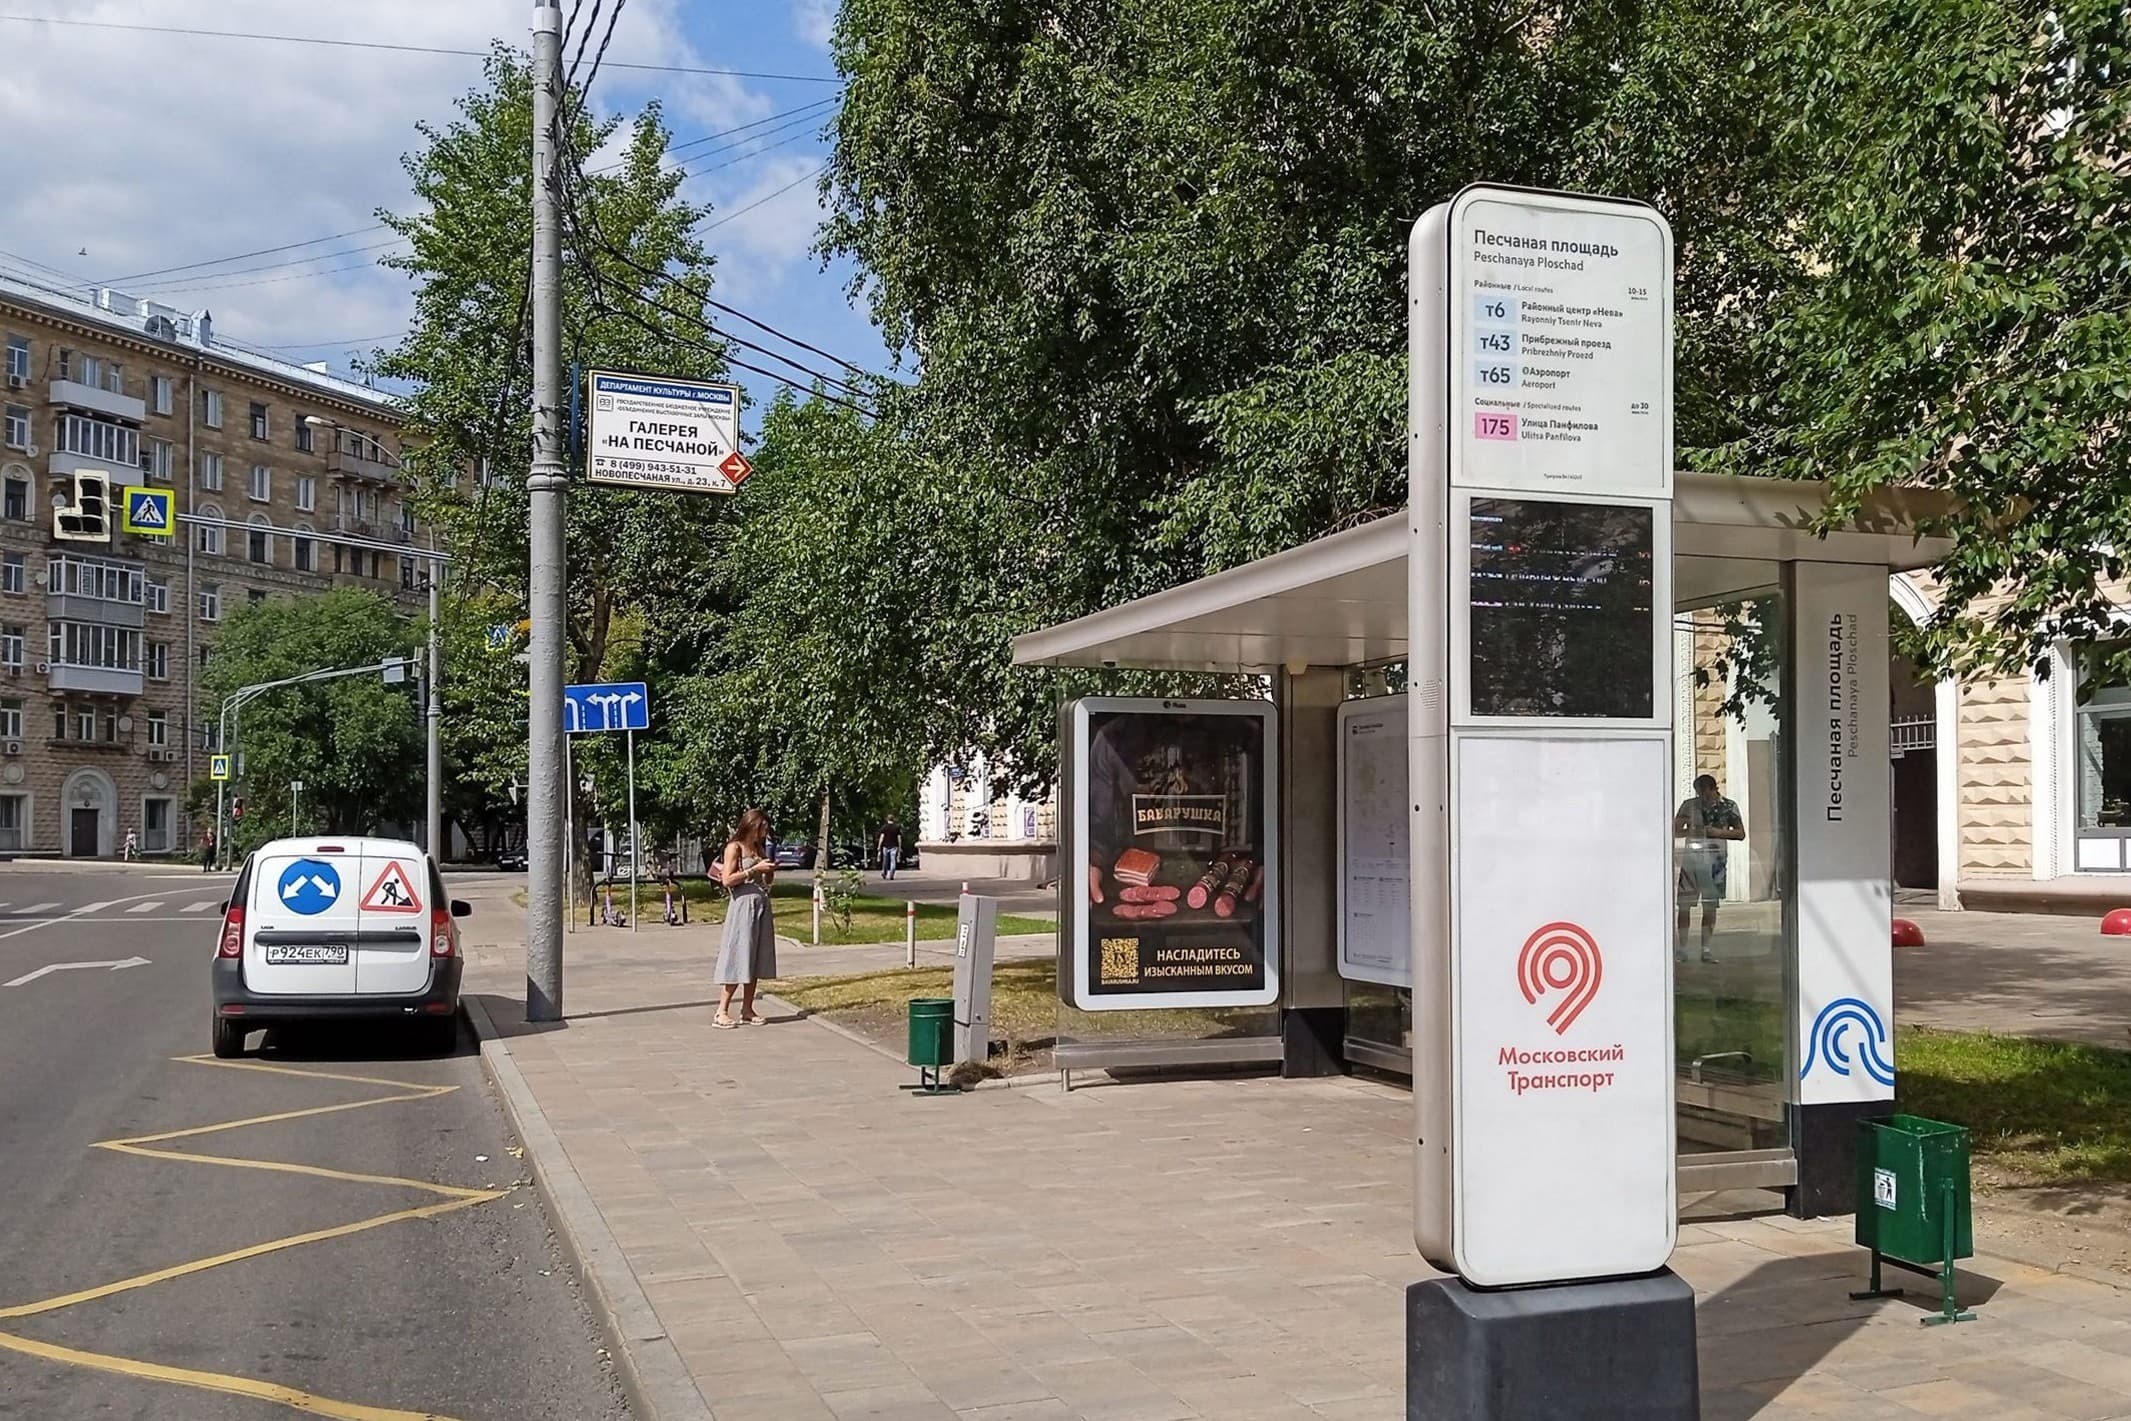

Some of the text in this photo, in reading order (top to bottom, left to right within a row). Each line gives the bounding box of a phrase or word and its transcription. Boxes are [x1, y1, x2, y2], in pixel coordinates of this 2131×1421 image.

[1474, 229, 1619, 258] Песчаная площадь
[1474, 251, 1584, 271] Peschanaya Ploschad
[1474, 279, 1511, 291] Районные
[1628, 287, 1647, 296] 10-15
[1485, 302, 1505, 319] т6
[1521, 301, 1565, 314] Районный
[1566, 305, 1592, 317] центр
[1521, 314, 1603, 328] Rayonniy Tsentr Neva
[1480, 334, 1510, 351] т43
[1521, 333, 1612, 350] Прибрежный проезд
[1521, 347, 1594, 360] Pribrezhniy Proezd
[1480, 367, 1511, 384] т65
[1529, 367, 1571, 379] Аэропорт
[600, 380, 652, 393] ДЕПАРТАМЕНТ
[653, 387, 691, 398] КУЛЬТУРЫ
[1521, 380, 1556, 390] Aeroport
[1474, 397, 1521, 408] Социальные
[1640, 402, 1649, 410] 30
[629, 420, 698, 438] ГАЛЕРЕЯ
[1481, 418, 1510, 435] 175
[1521, 417, 1599, 431] Улица Панфилова
[1521, 431, 1581, 442] Ulitsa Panfilova
[602, 435, 724, 457] «НА ПЕСЧАНОЙ»
[610, 459, 697, 475] 8 (499) 943-51-31
[595, 469, 671, 483] НОВОПЕСЧАНАЯ
[1847, 614, 1860, 758] Peschanaya Ploschad
[1827, 613, 1844, 821] Песчаная площадь
[1137, 807, 1221, 822] БАВАРУШКА
[271, 946, 345, 959] Р924ЕК 790
[1156, 948, 1241, 962] НАСЛАДИТЕСЬ
[1144, 964, 1253, 977] ИЗЫСКАННЫМ ВКУСОМ
[1498, 1043, 1624, 1066] Московский
[1507, 1070, 1615, 1096] Транспорт
